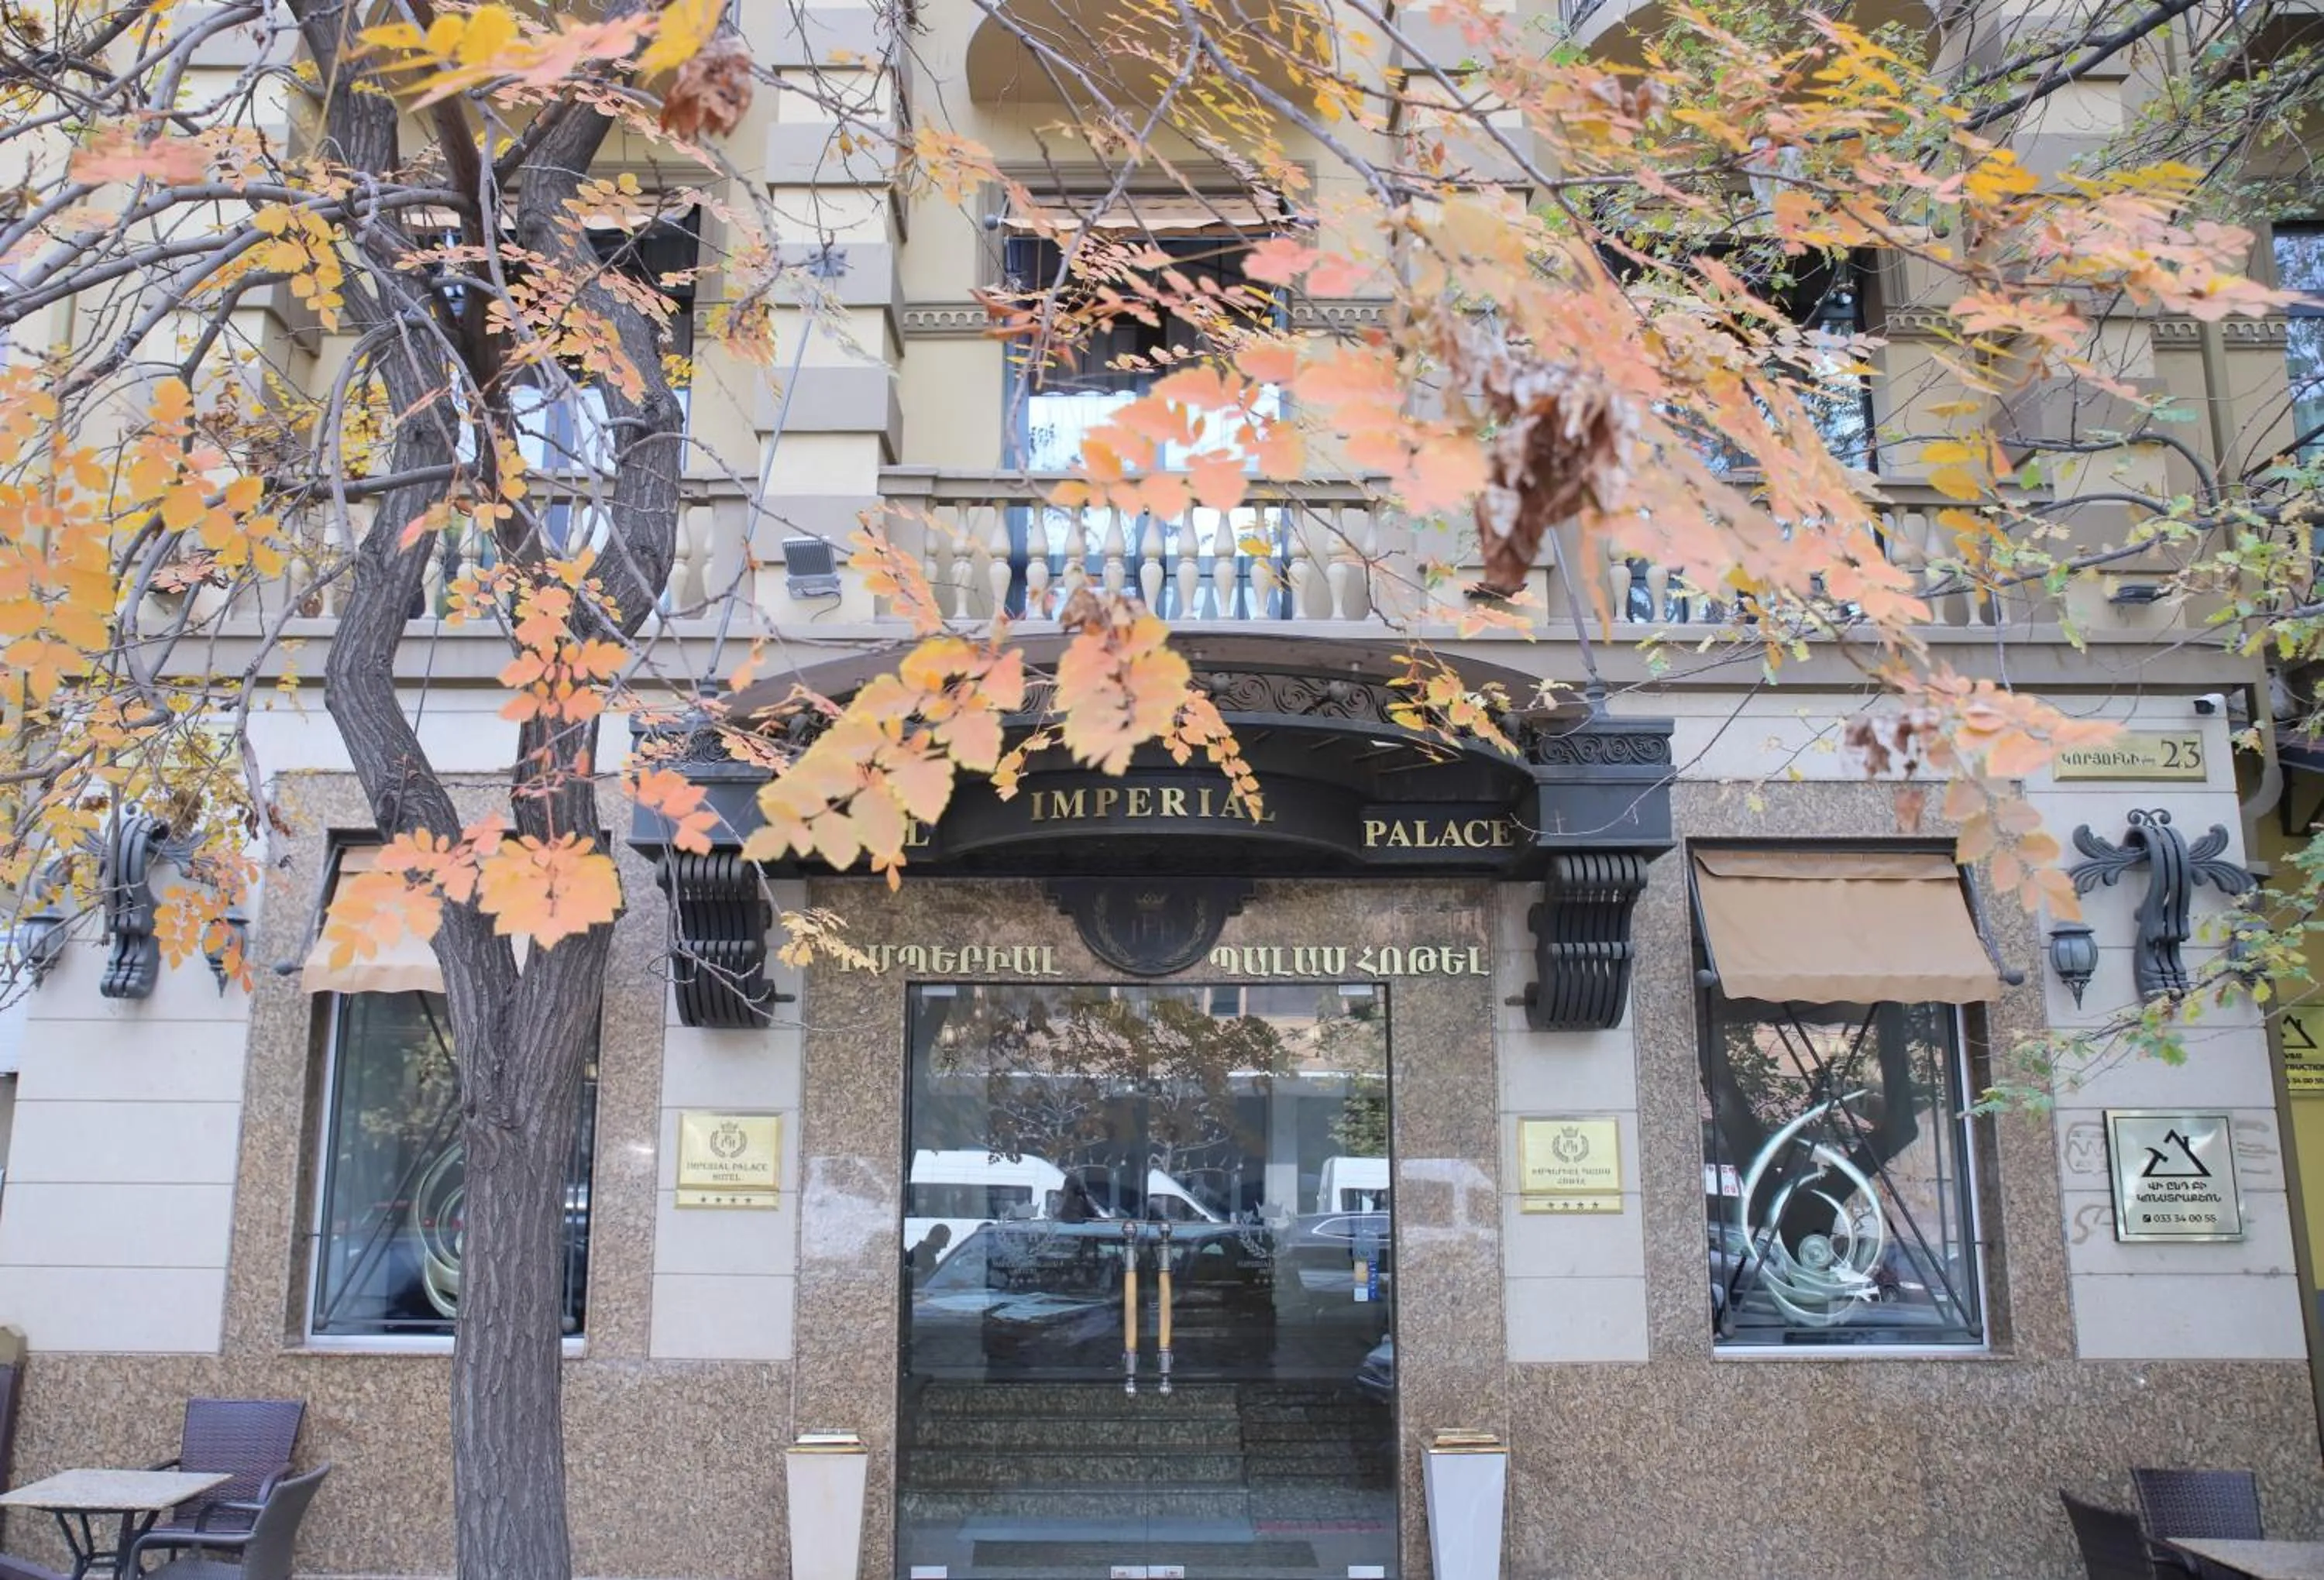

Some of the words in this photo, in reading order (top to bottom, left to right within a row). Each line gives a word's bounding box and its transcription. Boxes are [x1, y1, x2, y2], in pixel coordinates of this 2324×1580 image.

[2161, 740, 2201, 769] 23
[1363, 819, 1514, 848] PALACE
[1210, 946, 1347, 977] ՊԱԼԱՍ
[1356, 945, 1490, 977] ՀՈԹԵԼ
[2154, 1214, 2172, 1223] 033
[2174, 1214, 2187, 1223] 34
[2188, 1214, 2202, 1223] 00
[2204, 1214, 2218, 1223] 55
